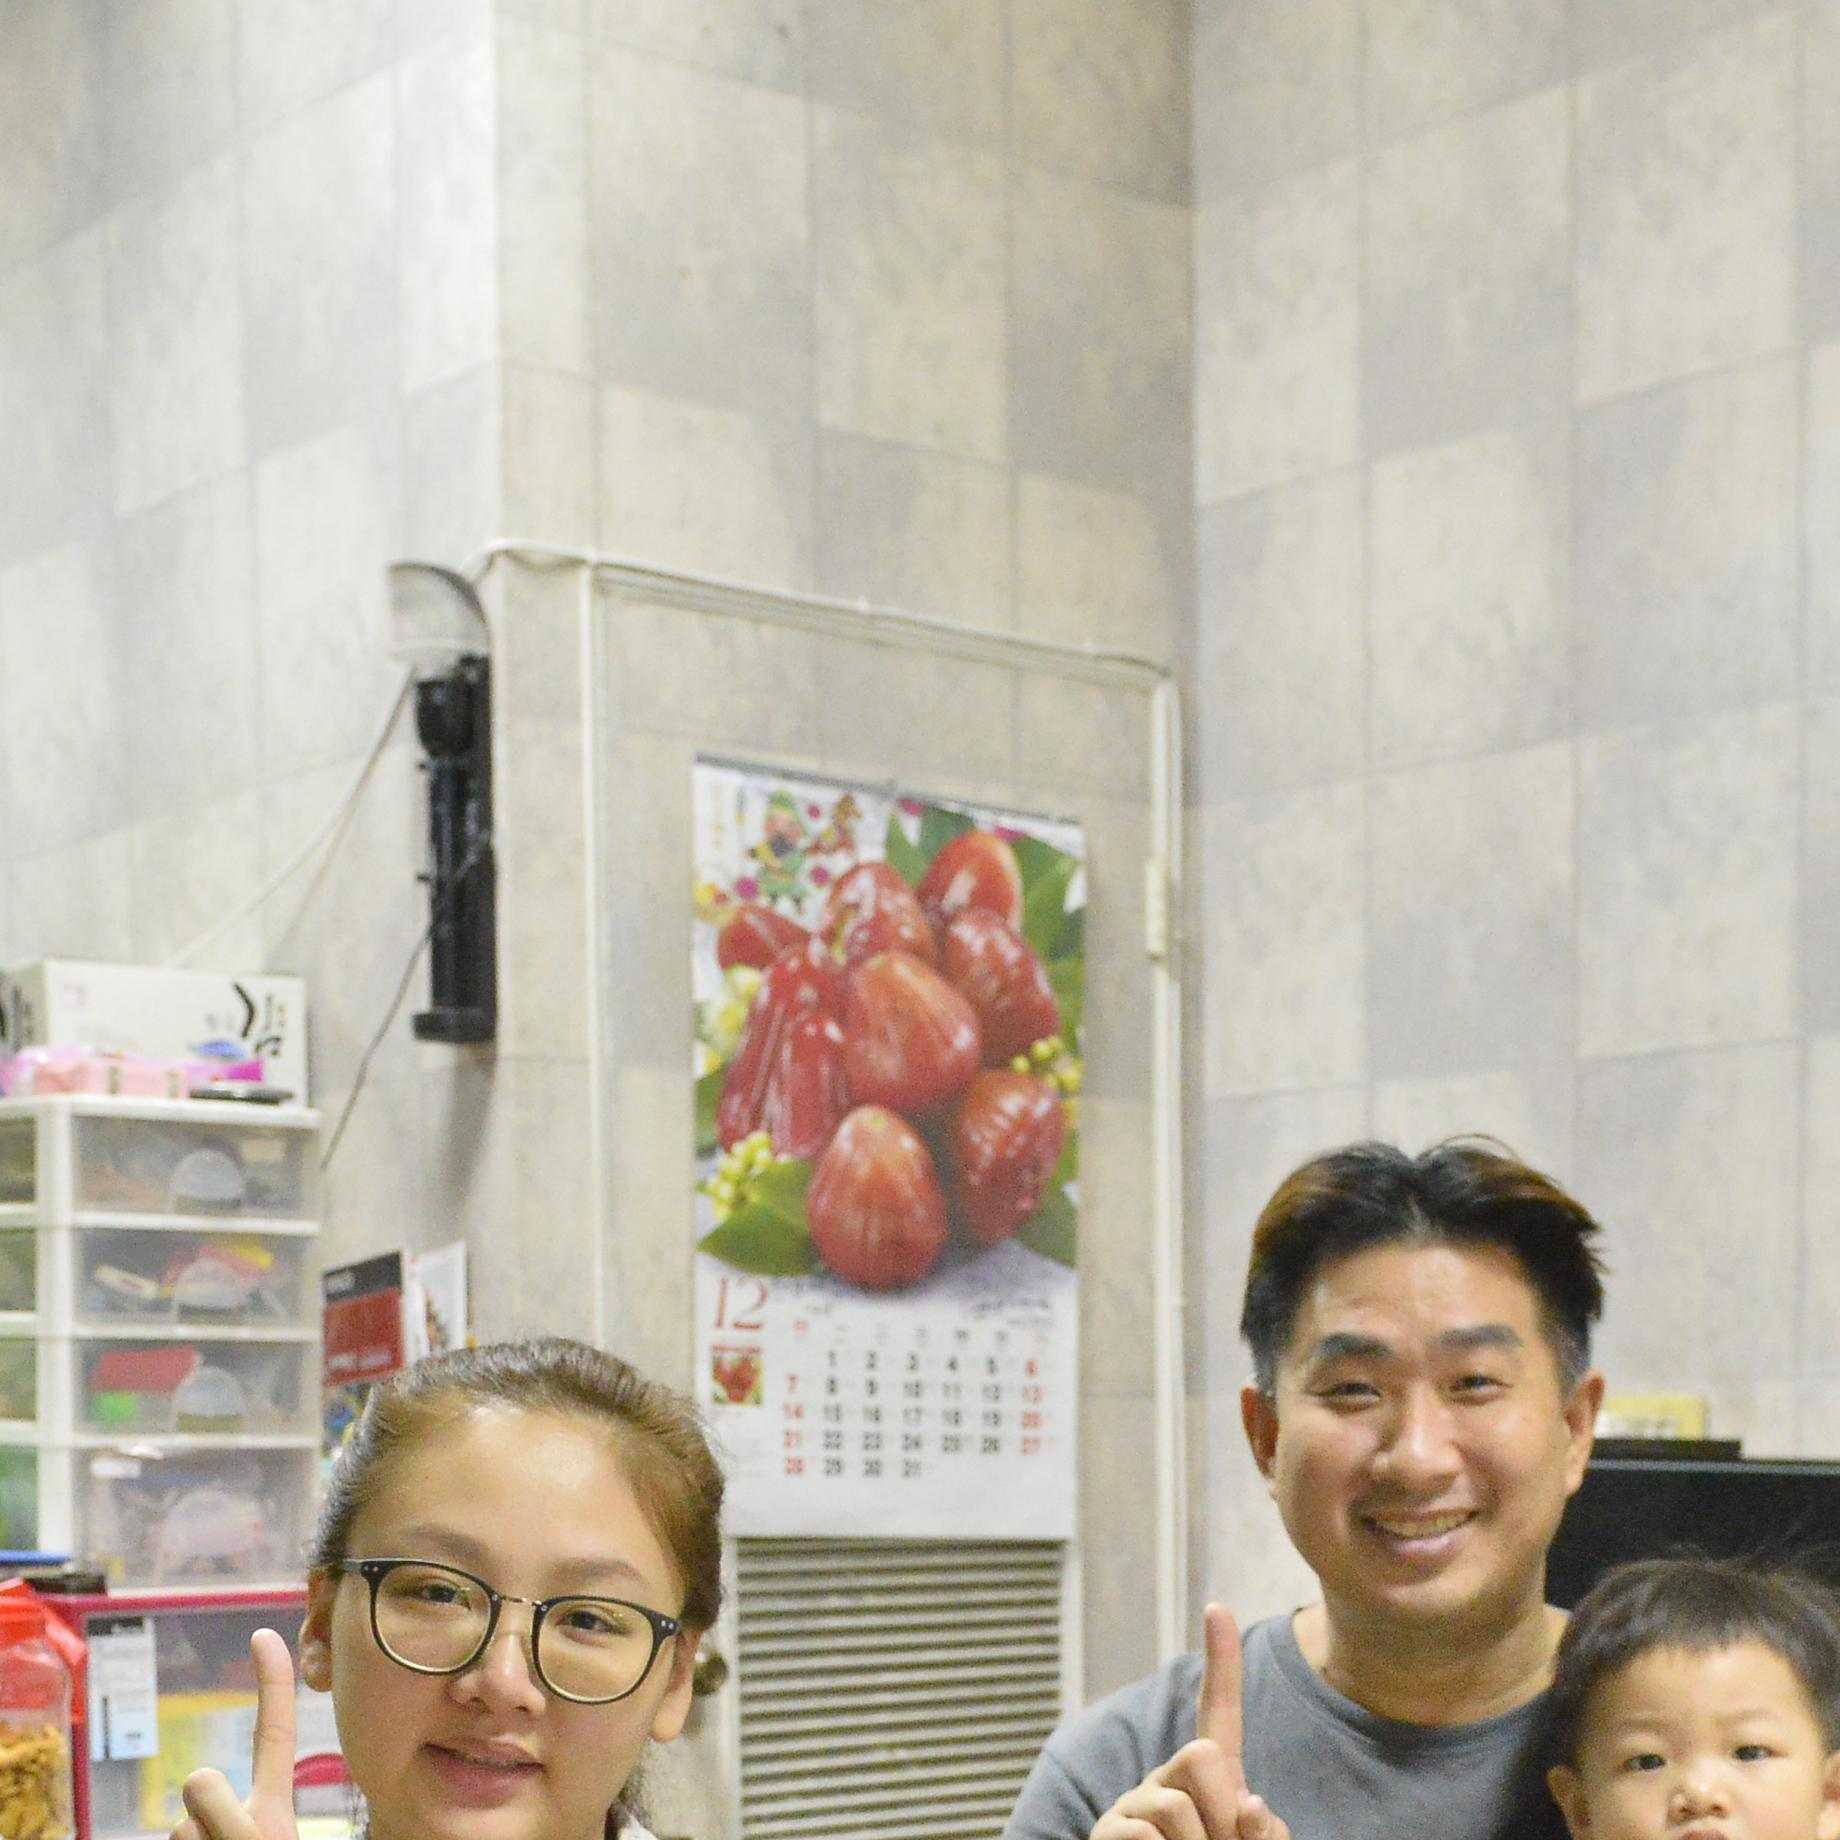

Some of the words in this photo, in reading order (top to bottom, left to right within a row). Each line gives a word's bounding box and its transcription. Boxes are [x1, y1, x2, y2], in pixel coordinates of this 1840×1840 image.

[715, 1276, 768, 1329] 12
[866, 1351, 878, 1370] 2
[906, 1352, 919, 1372] 3
[948, 1356, 959, 1372] 4
[866, 1378, 878, 1397] 9
